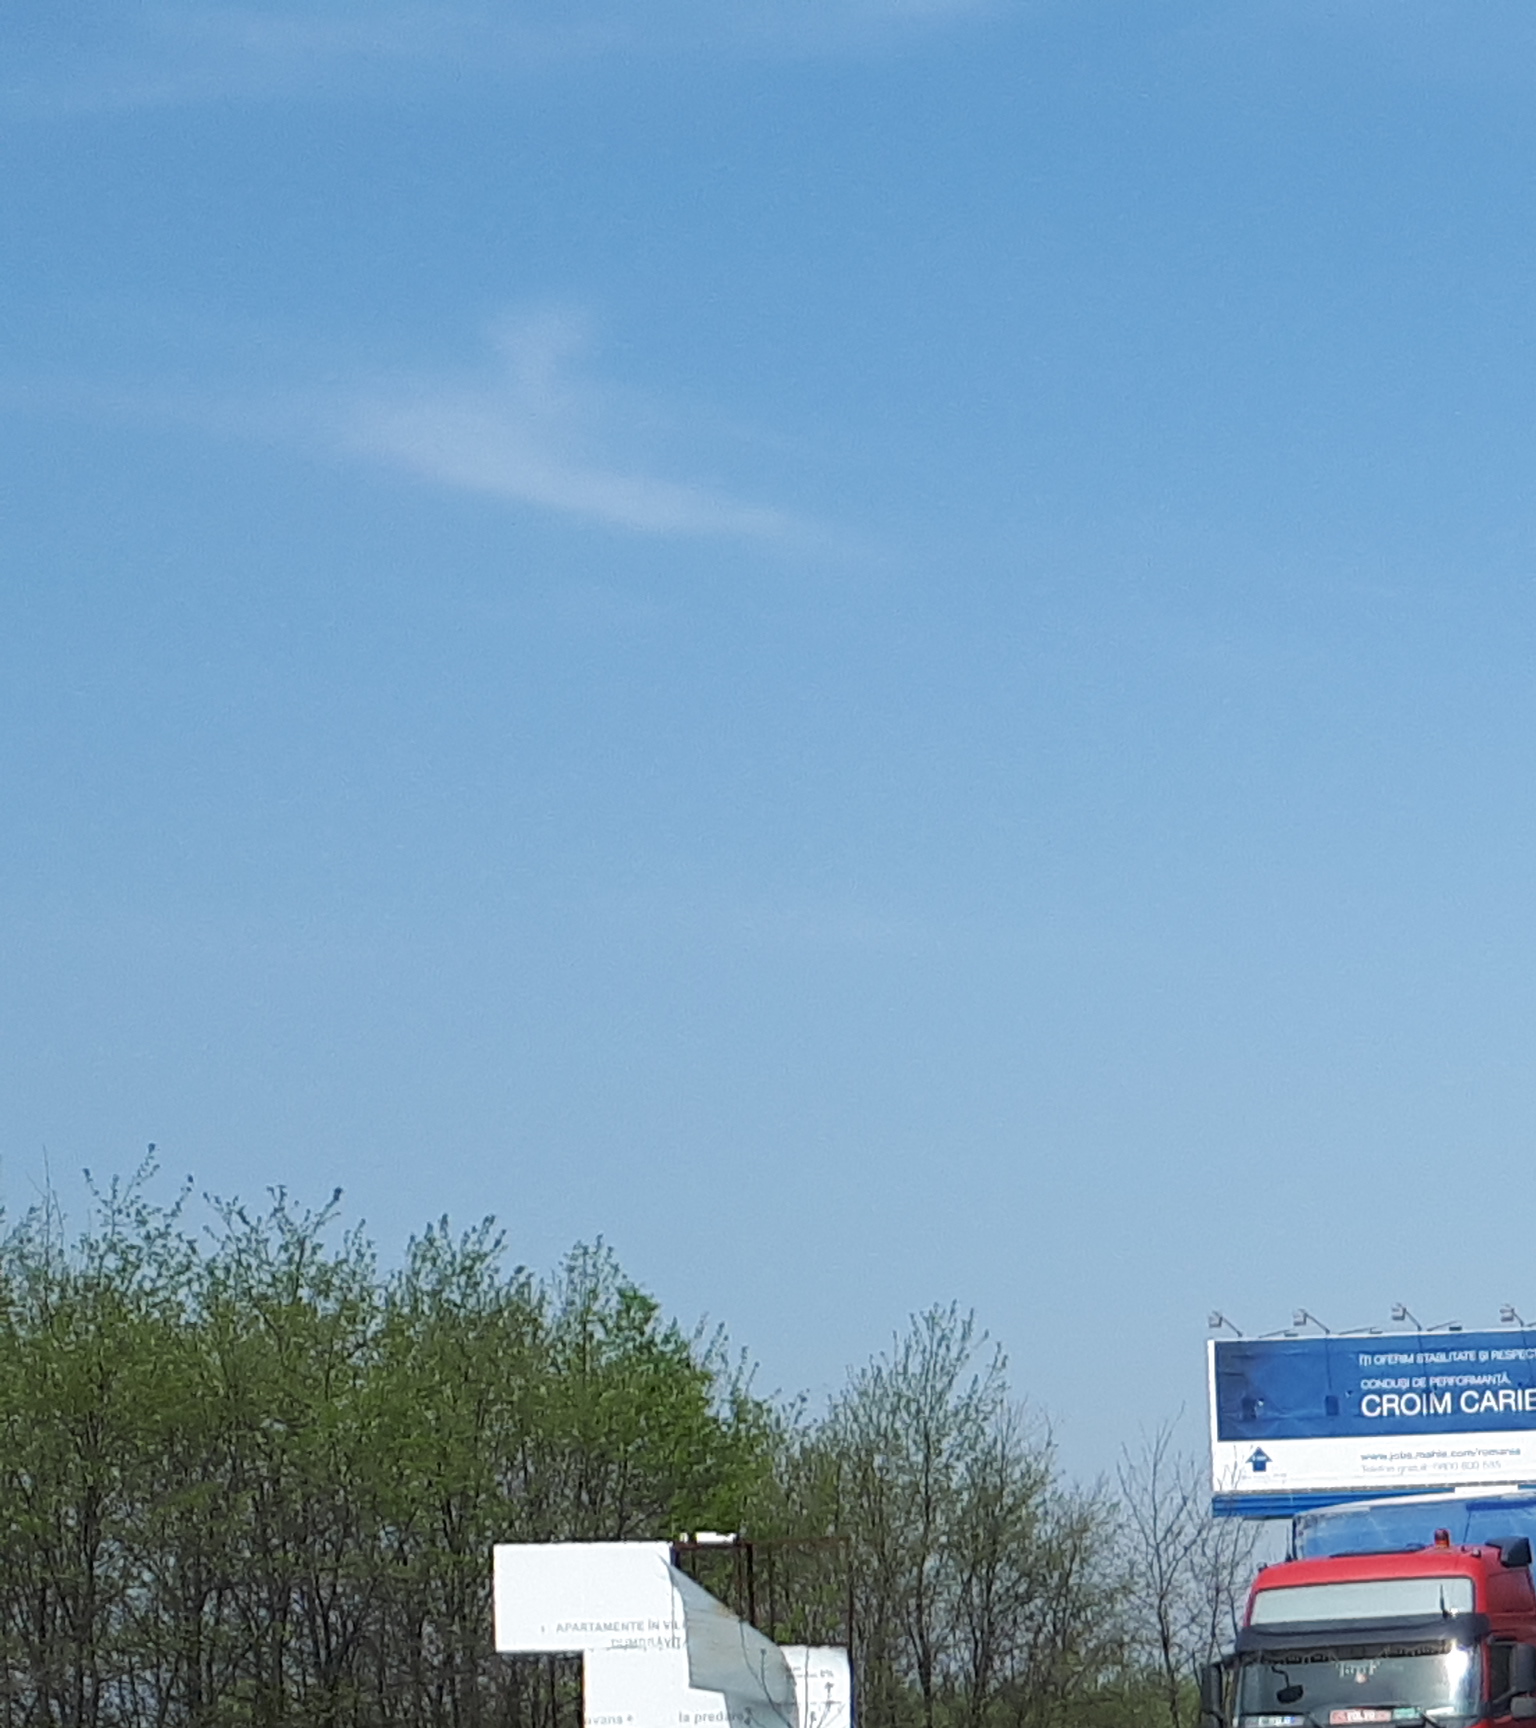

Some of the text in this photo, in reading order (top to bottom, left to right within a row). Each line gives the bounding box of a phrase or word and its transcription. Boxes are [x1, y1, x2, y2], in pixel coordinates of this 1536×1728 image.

[1373, 1353, 1414, 1365] OFERIM
[1412, 1376, 1426, 1388] DE
[1361, 1391, 1452, 1417] CROIM
[556, 1621, 644, 1633] APARTAMENTE
